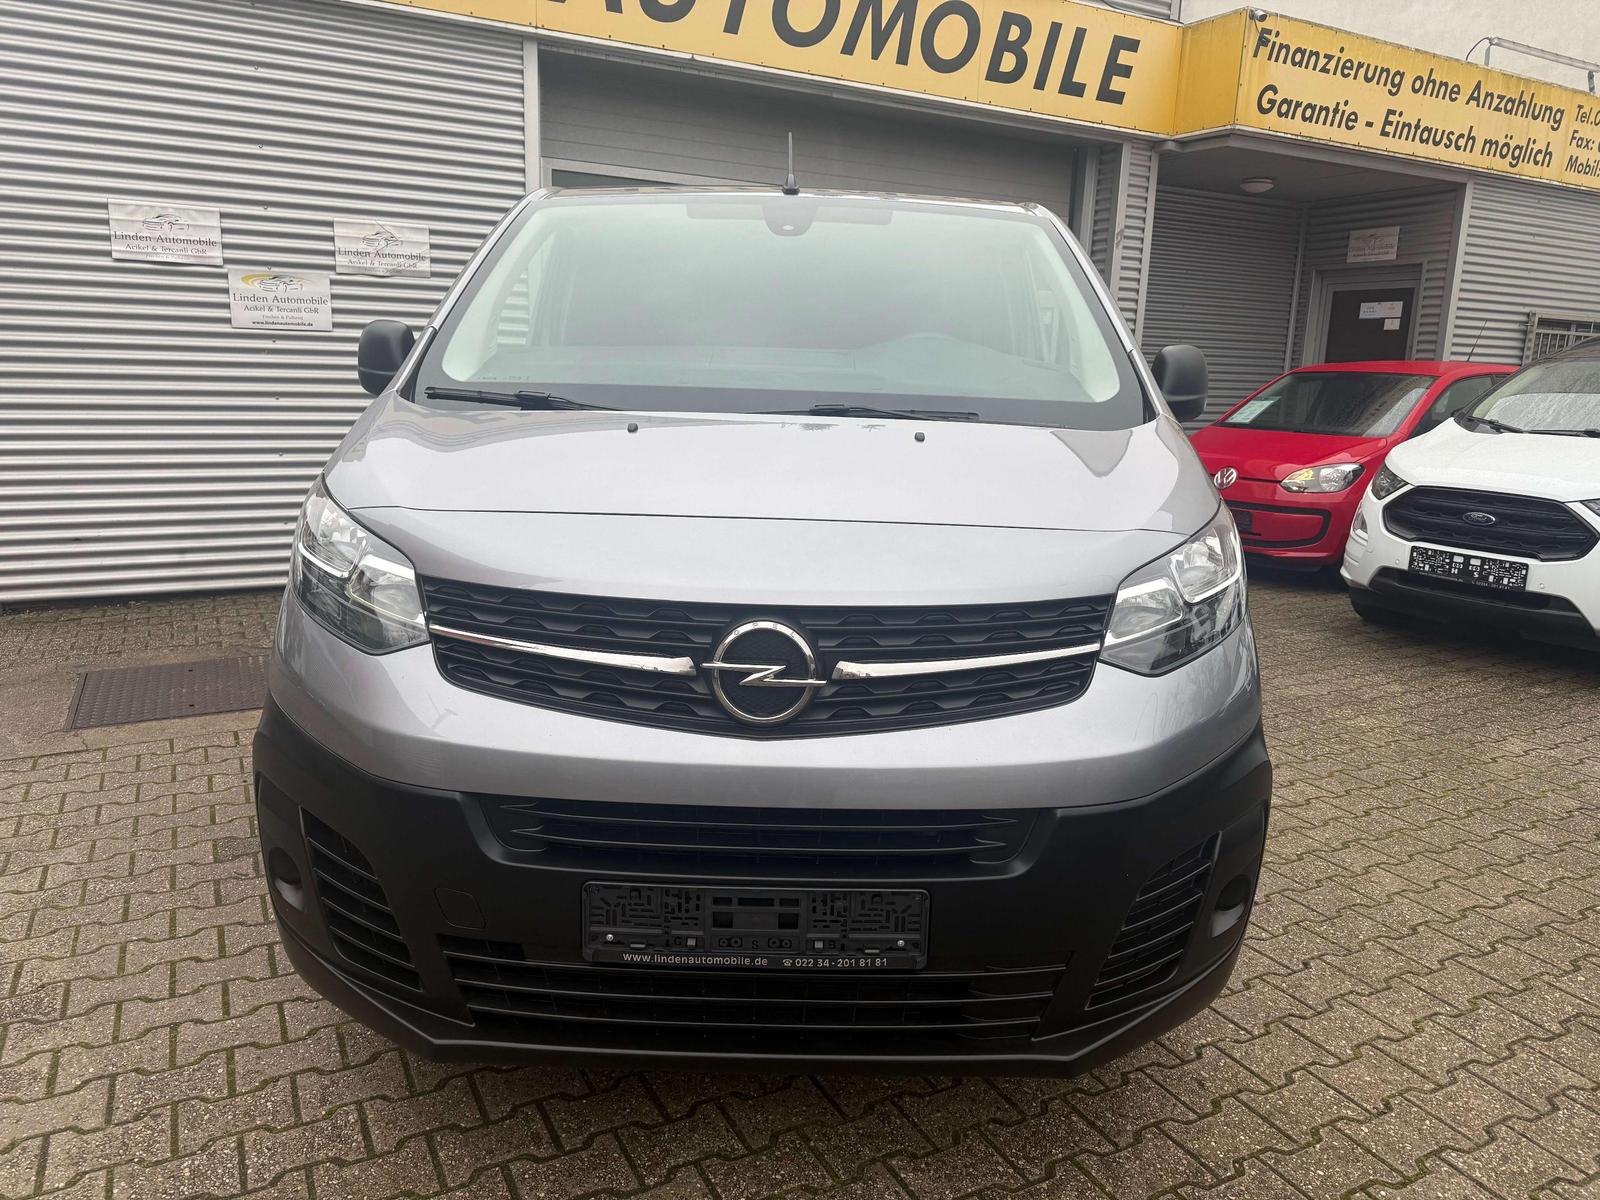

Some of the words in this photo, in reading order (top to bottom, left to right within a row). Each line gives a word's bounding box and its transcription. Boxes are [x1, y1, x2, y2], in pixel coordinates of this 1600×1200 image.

[1252, 27, 1405, 97] Finanzierung
[1411, 68, 1461, 102] ohne
[1465, 79, 1565, 132] Anzahlung
[1256, 83, 1359, 130] Garantie
[1364, 120, 1374, 128] -
[1379, 108, 1477, 154] Eintausch
[1479, 133, 1553, 168] möglich
[1569, 129, 1595, 151] Fax:
[114, 230, 152, 242] Linden
[156, 234, 217, 247] Automobile
[338, 248, 370, 258] Linden
[374, 250, 427, 261] Automobile
[233, 293, 268, 303] Linden
[272, 295, 329, 305] Automobile
[623, 953, 768, 966] www.lindenautomobile.de
[795, 958, 814, 967] 022
[817, 958, 829, 967] 34
[837, 959, 855, 967] 201
[859, 958, 871, 967] 81
[875, 958, 887, 967] 81
